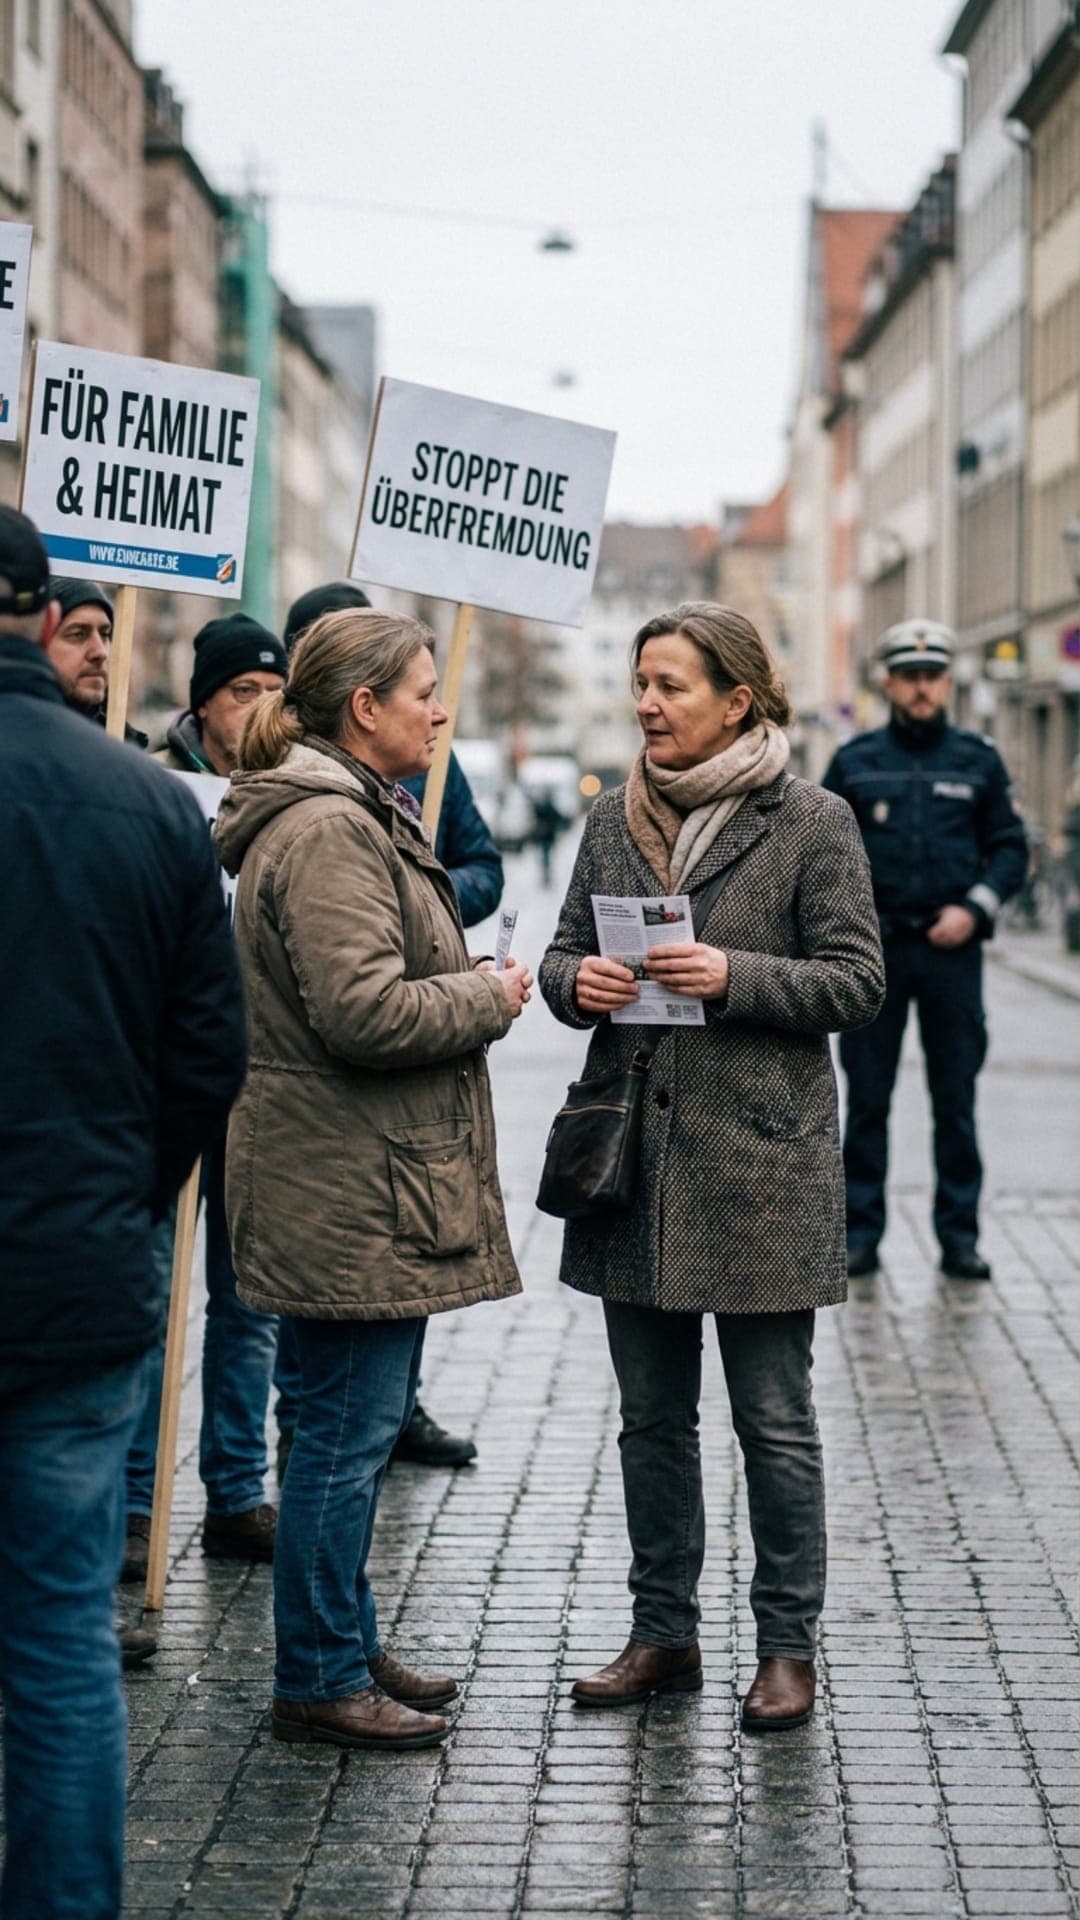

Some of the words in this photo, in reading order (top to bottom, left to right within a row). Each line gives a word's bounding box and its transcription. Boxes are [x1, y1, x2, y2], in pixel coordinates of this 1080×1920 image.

[41, 367, 109, 445] FÜR
[117, 390, 248, 467] FAMILIE
[56, 456, 84, 516] &
[93, 461, 222, 534] HEIMAT
[412, 441, 519, 502] STOPPT
[522, 467, 569, 514] DIE
[371, 475, 591, 571] ÜBERFREMDUNG
